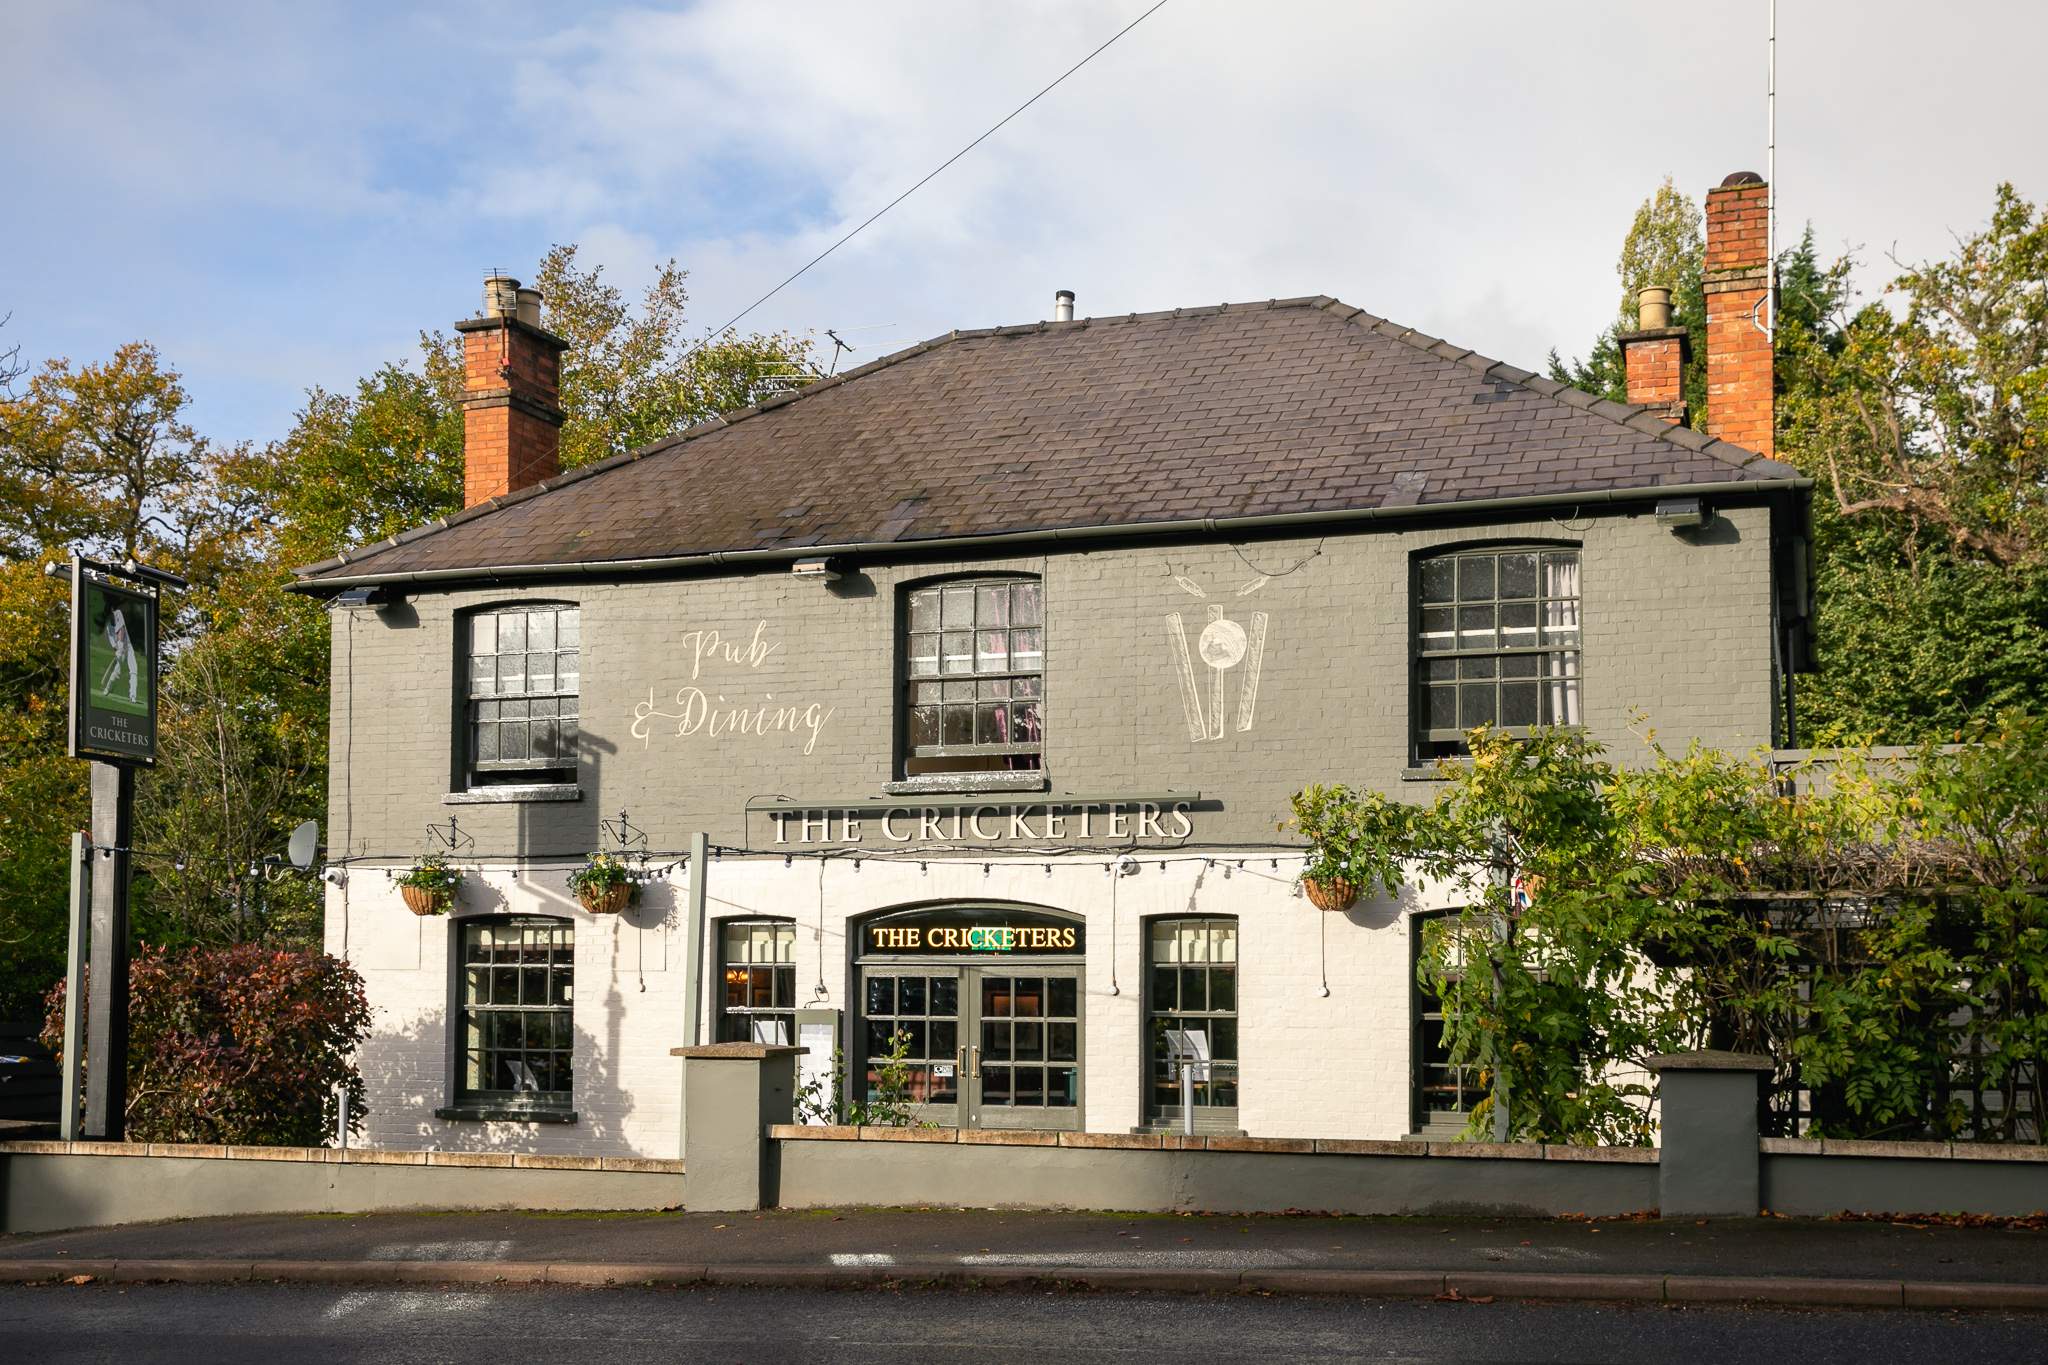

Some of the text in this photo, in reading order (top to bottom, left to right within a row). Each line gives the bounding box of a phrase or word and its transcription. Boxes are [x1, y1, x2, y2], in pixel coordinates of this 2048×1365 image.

[682, 619, 781, 680] Pub
[89, 726, 149, 747] CRICKETERS
[111, 716, 128, 728] THE
[630, 686, 835, 756] & Dining
[768, 801, 1193, 844] THE CRICKETERS
[872, 927, 1076, 948] THE CRICKETERS
